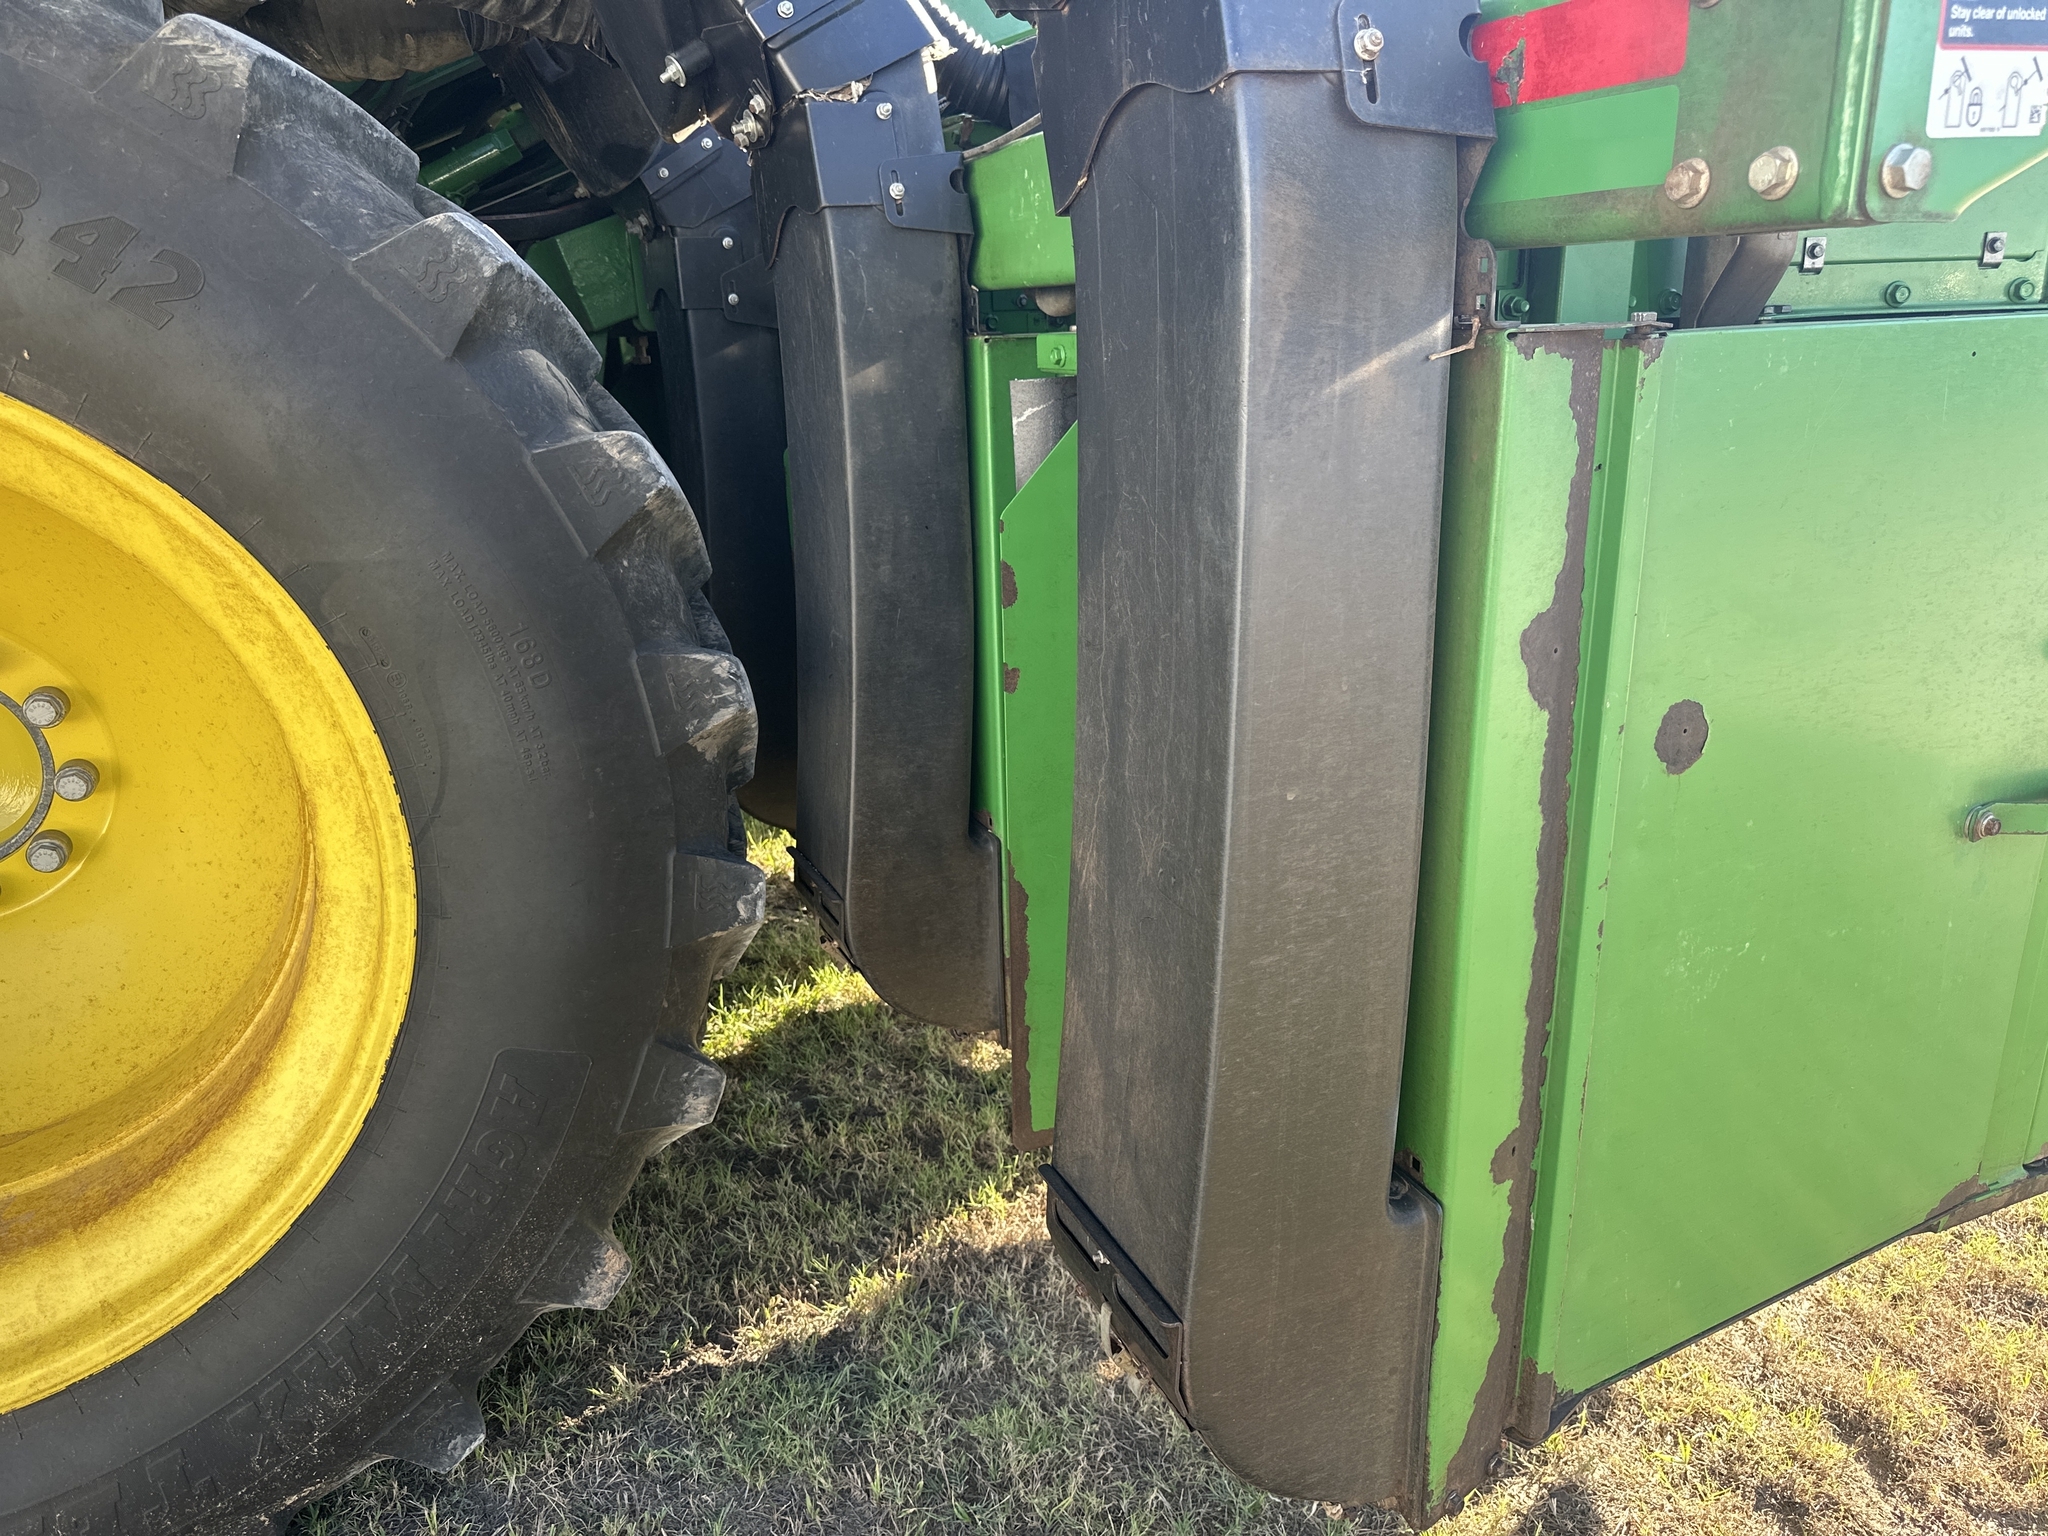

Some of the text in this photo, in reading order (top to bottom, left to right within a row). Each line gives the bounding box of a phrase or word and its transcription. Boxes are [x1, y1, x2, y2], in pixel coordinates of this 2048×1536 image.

[1948, 24, 1974, 38] units.
[1951, 4, 2047, 22] Stay clear of unlocked
[428, 559, 453, 591] MAX.
[491, 673, 508, 687] AT
[513, 729, 528, 743] AT
[441, 551, 466, 583] MAX.
[463, 583, 489, 616] LOAD
[506, 664, 522, 680] AT
[528, 725, 544, 740] AT
